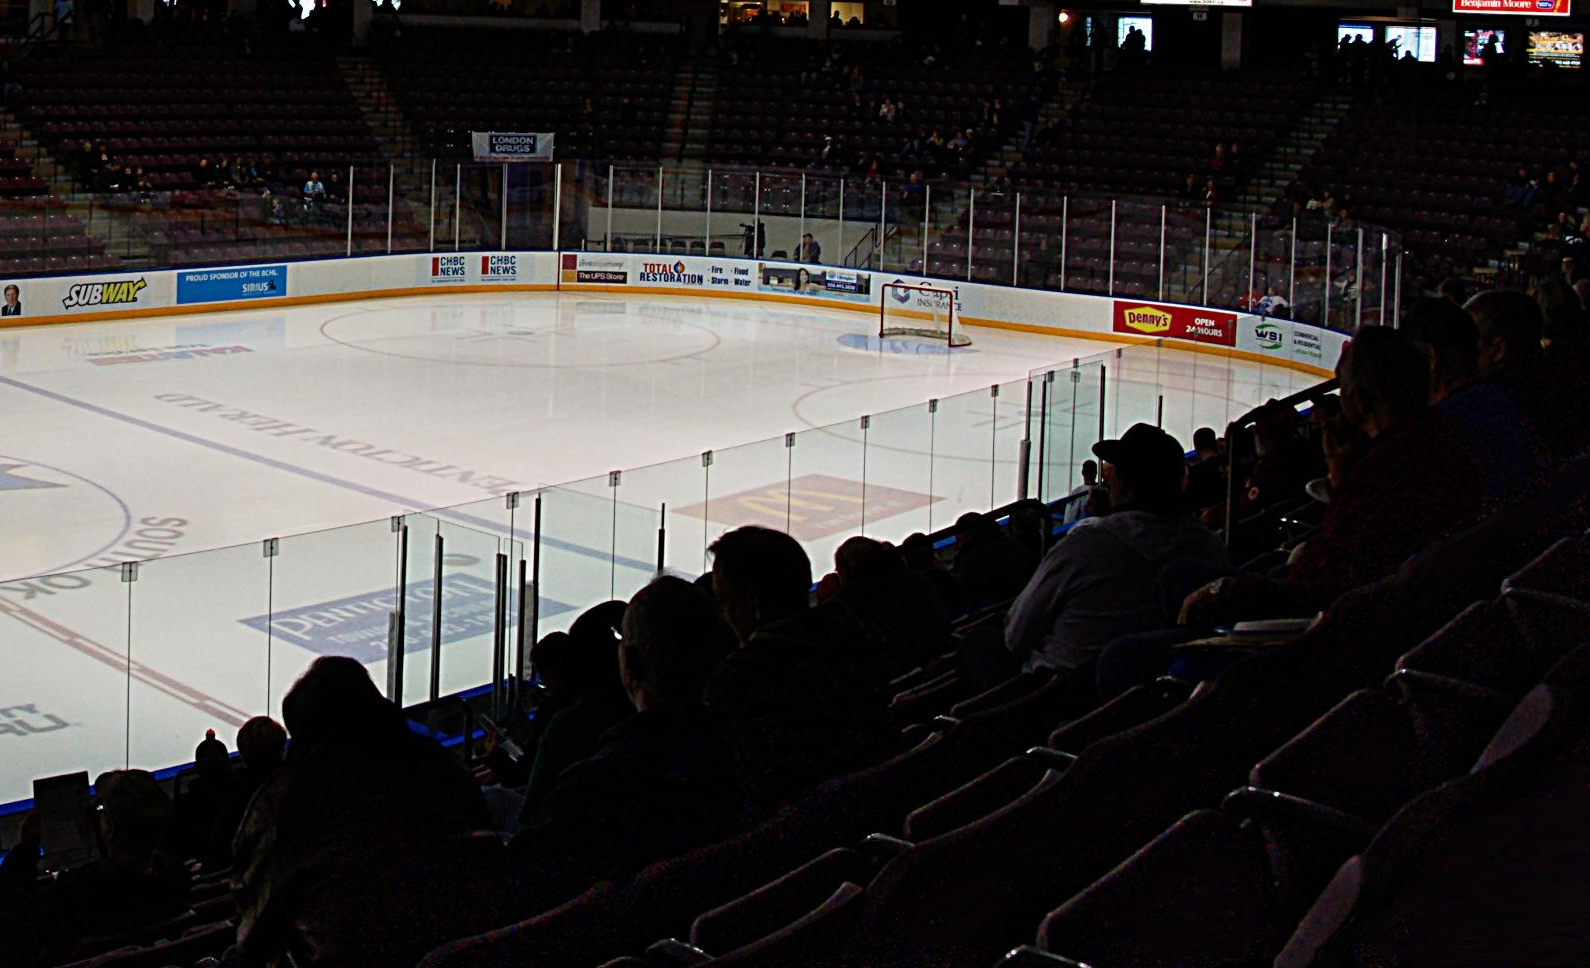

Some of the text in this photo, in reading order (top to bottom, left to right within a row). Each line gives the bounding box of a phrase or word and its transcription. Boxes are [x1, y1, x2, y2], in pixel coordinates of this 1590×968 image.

[492, 136, 534, 144] LONDON
[495, 144, 531, 152] DRUGS
[440, 256, 465, 266] CHBC
[490, 255, 516, 265] CHBC
[440, 267, 465, 276] NEWS
[490, 266, 516, 275] NEWS
[642, 263, 672, 274] TOTAL
[711, 265, 749, 276] Fire Flood
[185, 274, 208, 282] PROUD
[209, 272, 238, 281] SPONSOR
[240, 271, 248, 279] OF
[249, 270, 260, 278] THE
[579, 272, 624, 281] The UPS Store
[639, 272, 703, 284] RESTORATION
[711, 277, 751, 287] Storm Water
[242, 282, 269, 293] SIRIUS
[62, 277, 147, 309] SUBWAY
[1128, 311, 1169, 328] Denny's
[1194, 317, 1215, 327] OPEN
[1255, 329, 1283, 342] WSI
